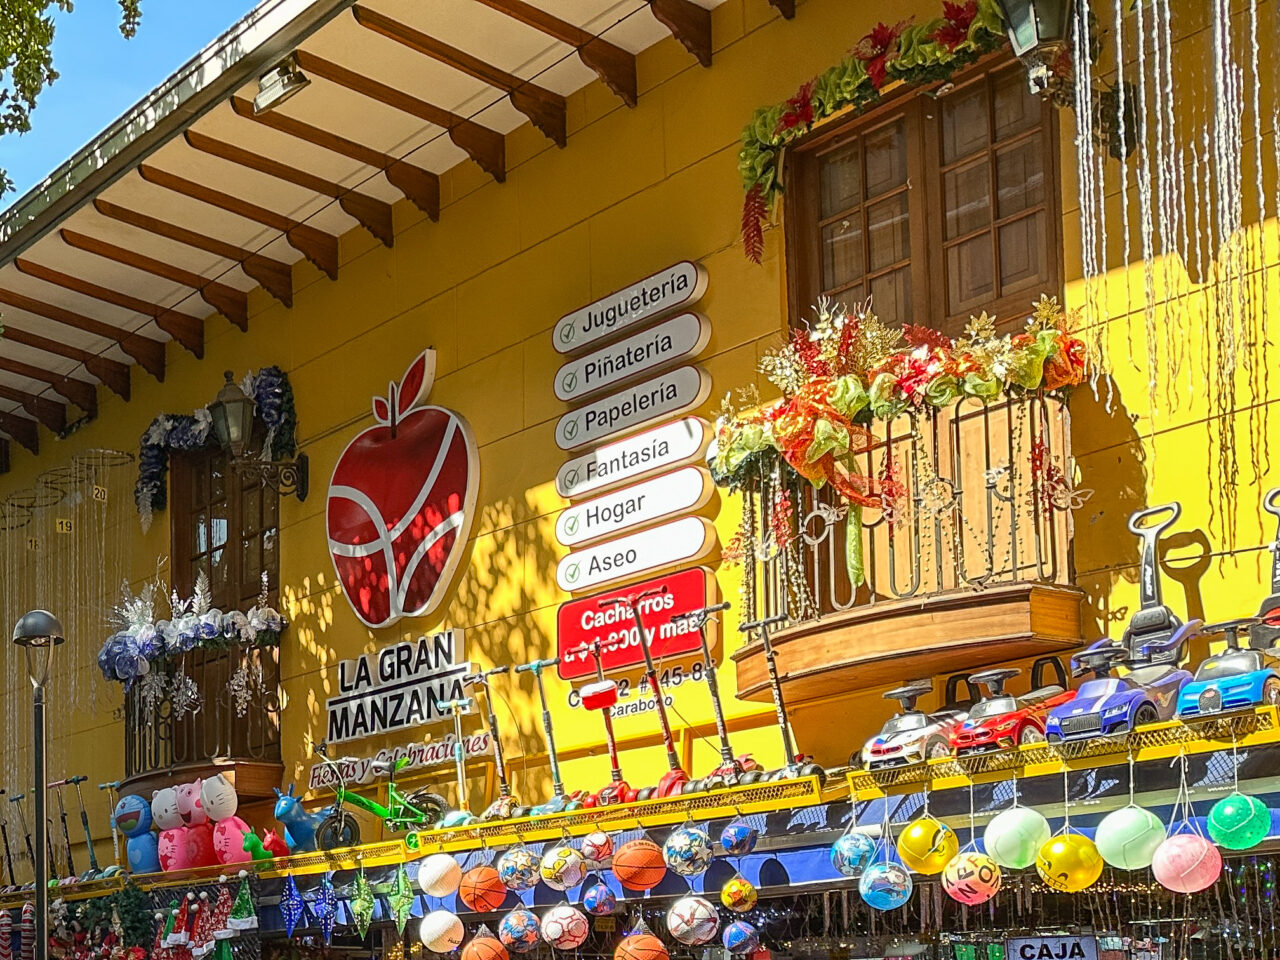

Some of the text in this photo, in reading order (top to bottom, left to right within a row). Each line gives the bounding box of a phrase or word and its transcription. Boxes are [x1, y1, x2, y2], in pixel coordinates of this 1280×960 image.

[582, 273, 688, 332] Juguetería
[584, 334, 673, 383] Piñatería
[585, 382, 678, 431] Papelería
[587, 439, 669, 481] Fantasía
[58, 520, 72, 532] 19
[587, 494, 646, 528] Hogar
[588, 549, 637, 576] Aseo
[340, 631, 453, 693] LA GRAN
[660, 660, 716, 688] 45-8
[328, 680, 467, 742] MANZANA
[610, 696, 673, 718] Caraboo
[358, 758, 370, 782] y
[1019, 942, 1086, 960] CAJA
